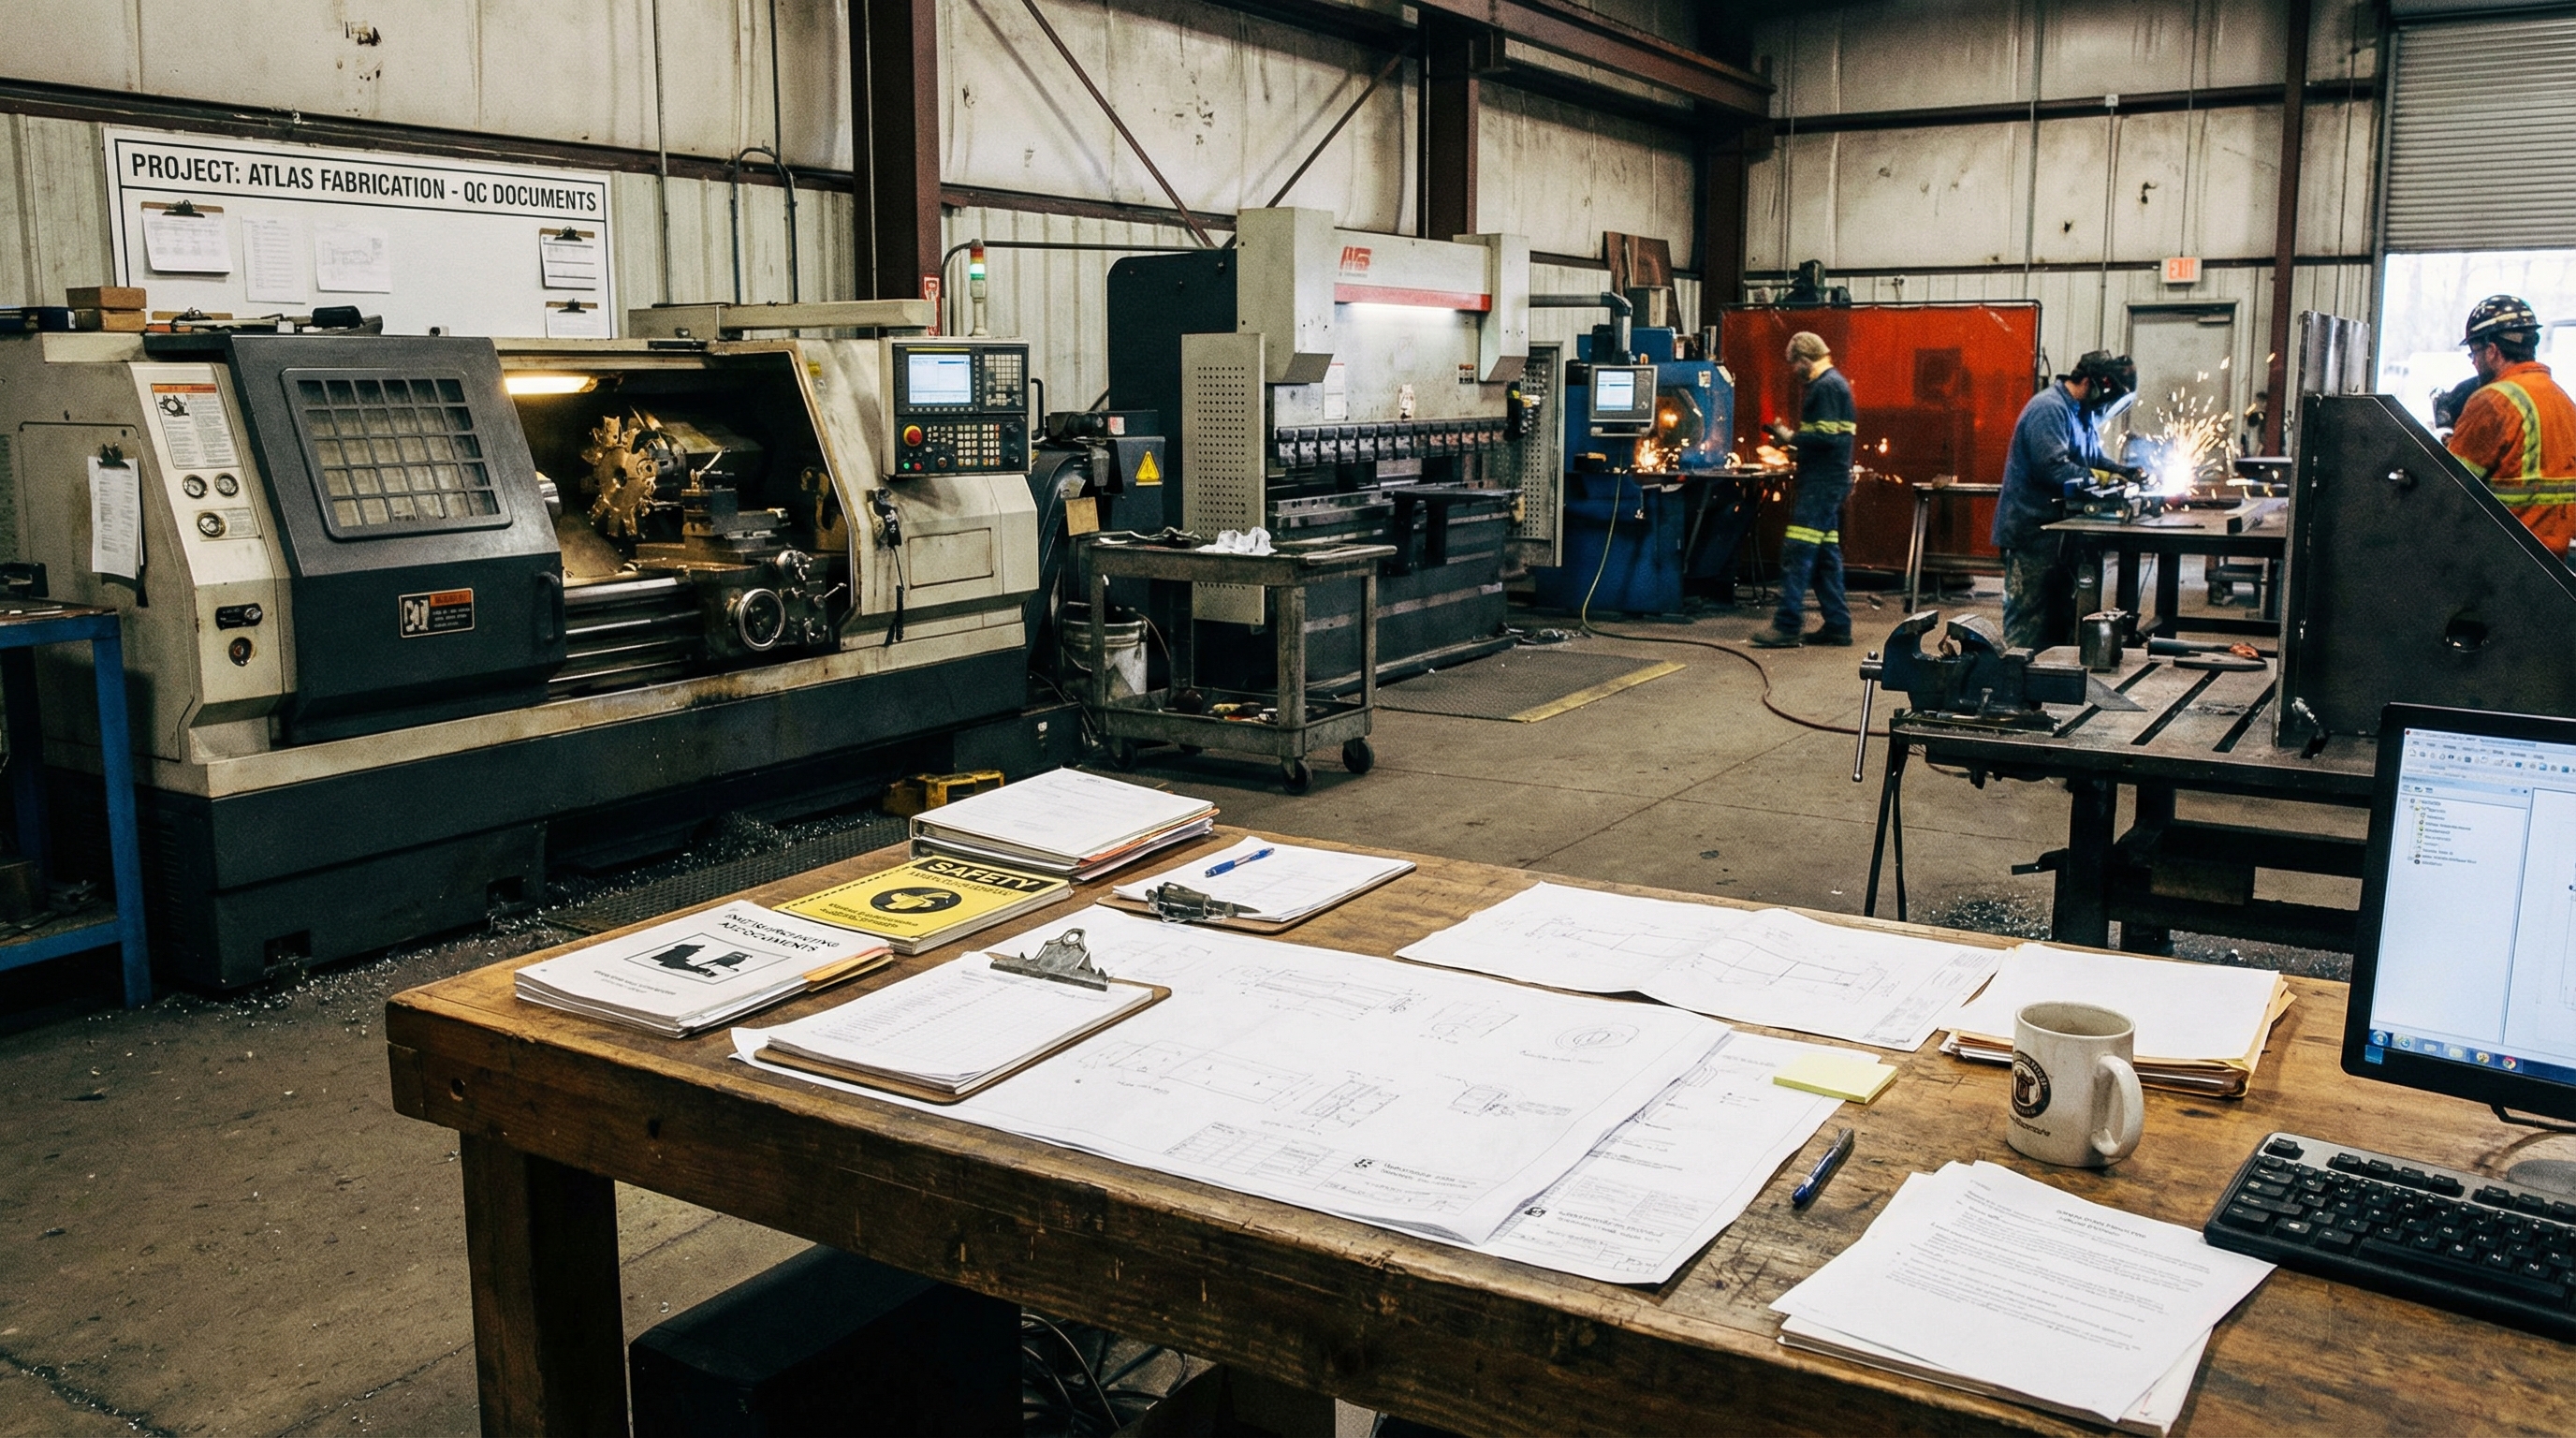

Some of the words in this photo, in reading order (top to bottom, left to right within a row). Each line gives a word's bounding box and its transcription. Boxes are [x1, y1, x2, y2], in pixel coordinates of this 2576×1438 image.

[131, 153, 241, 184] PROJECT:
[248, 163, 314, 190] ATLAS
[320, 169, 446, 199] FABRICATION
[463, 181, 488, 204] QC
[492, 183, 597, 212] DOCUMENTS
[928, 861, 1040, 889] SAFETY
